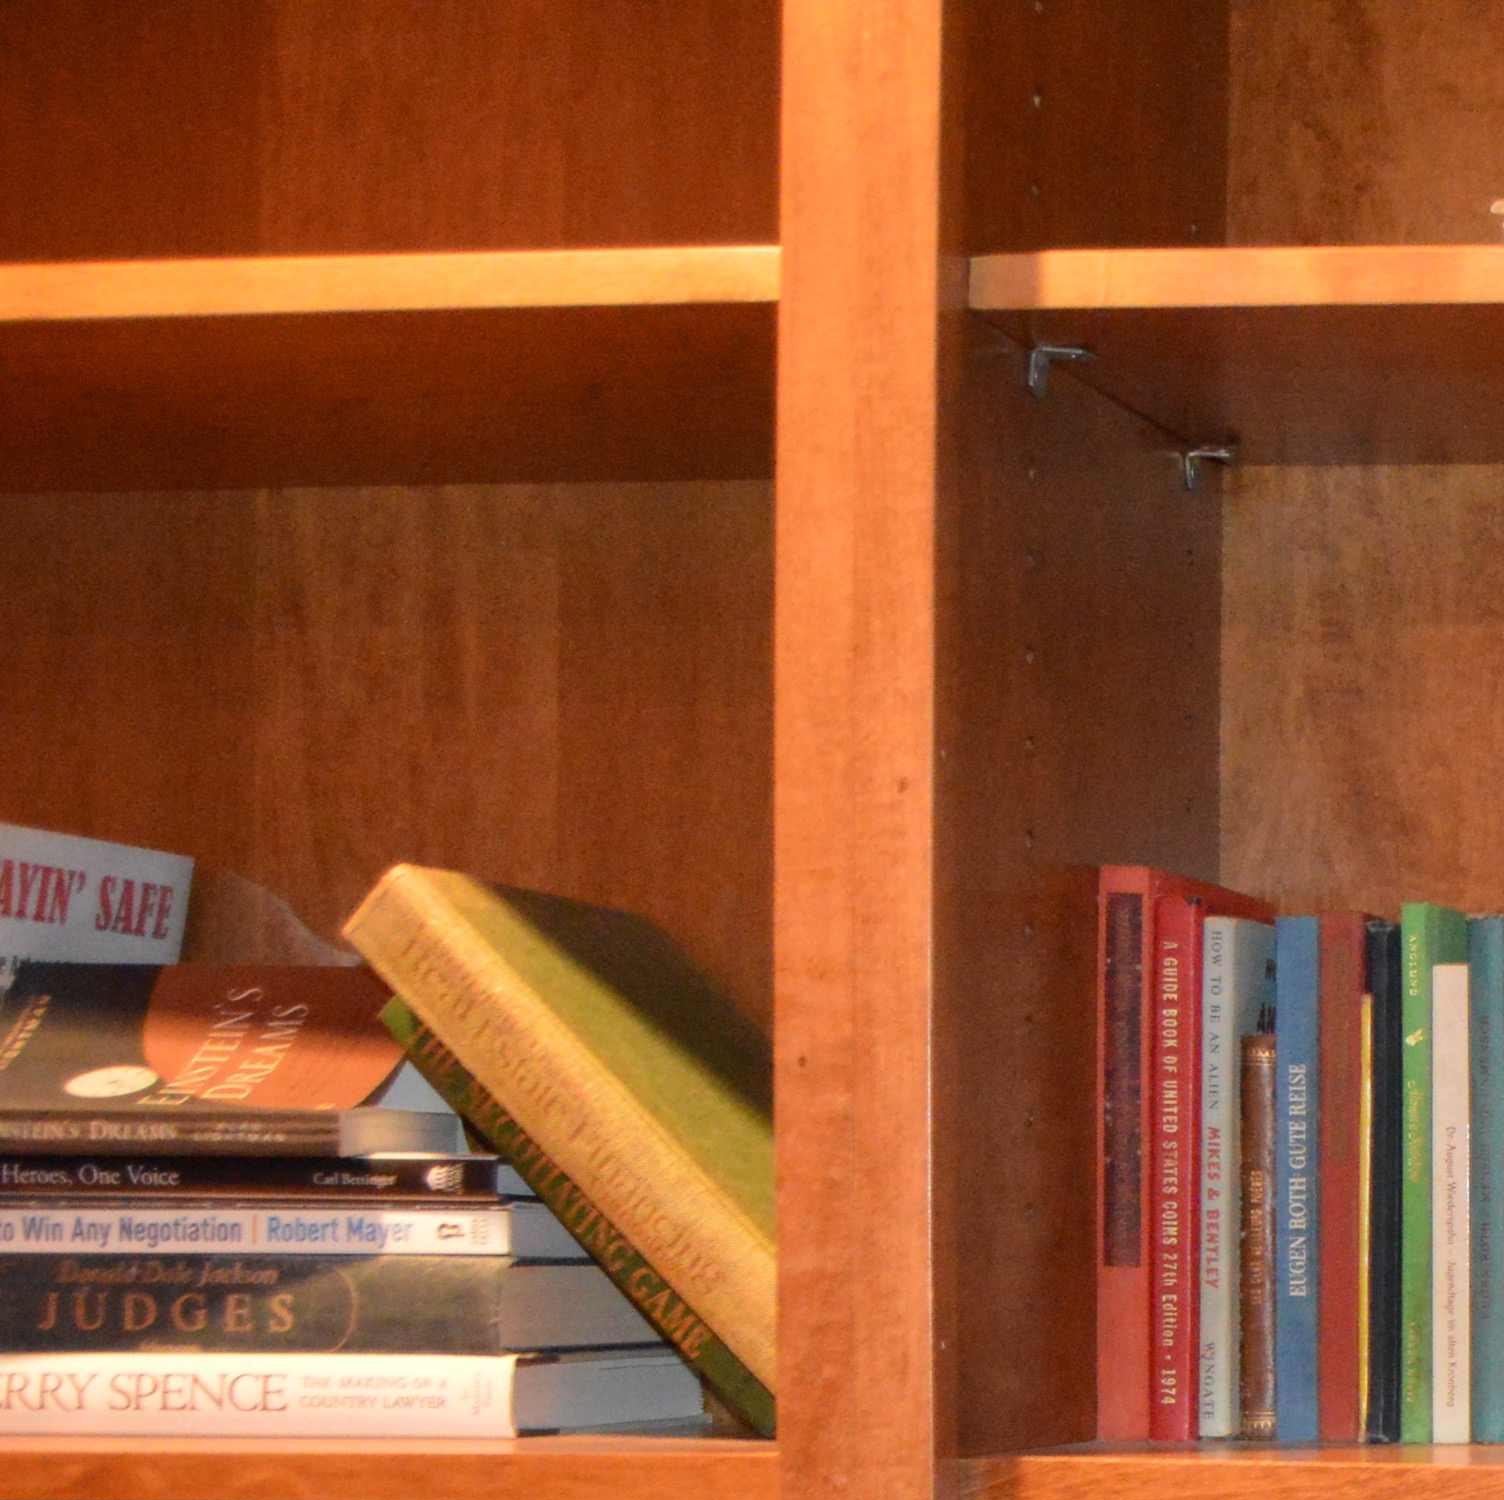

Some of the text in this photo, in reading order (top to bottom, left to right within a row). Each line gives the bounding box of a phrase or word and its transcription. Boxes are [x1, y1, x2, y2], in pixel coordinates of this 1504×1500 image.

[95, 875, 174, 940] SAFE
[137, 988, 263, 1105] EINSTEIN'S
[201, 1004, 309, 1099] DREAMS
[1204, 930, 1223, 1289] HOW TO BE AN ALIEN MIKES & BENTLEY
[0, 1162, 181, 1186] Heroes, One Voice
[1159, 940, 1180, 1405] A GUIDE BOOK OF UNITED STATES COINS 27th Edition 1974
[1287, 1063, 1308, 1297] EUGEN ROTH GUTE REISE
[21, 1214, 415, 1249] Win Any Negotiation Robert Mayer
[37, 1291, 294, 1333] JUDGES
[0, 1371, 99, 1411] RRY
[1200, 1340, 1216, 1420] WINGATE
